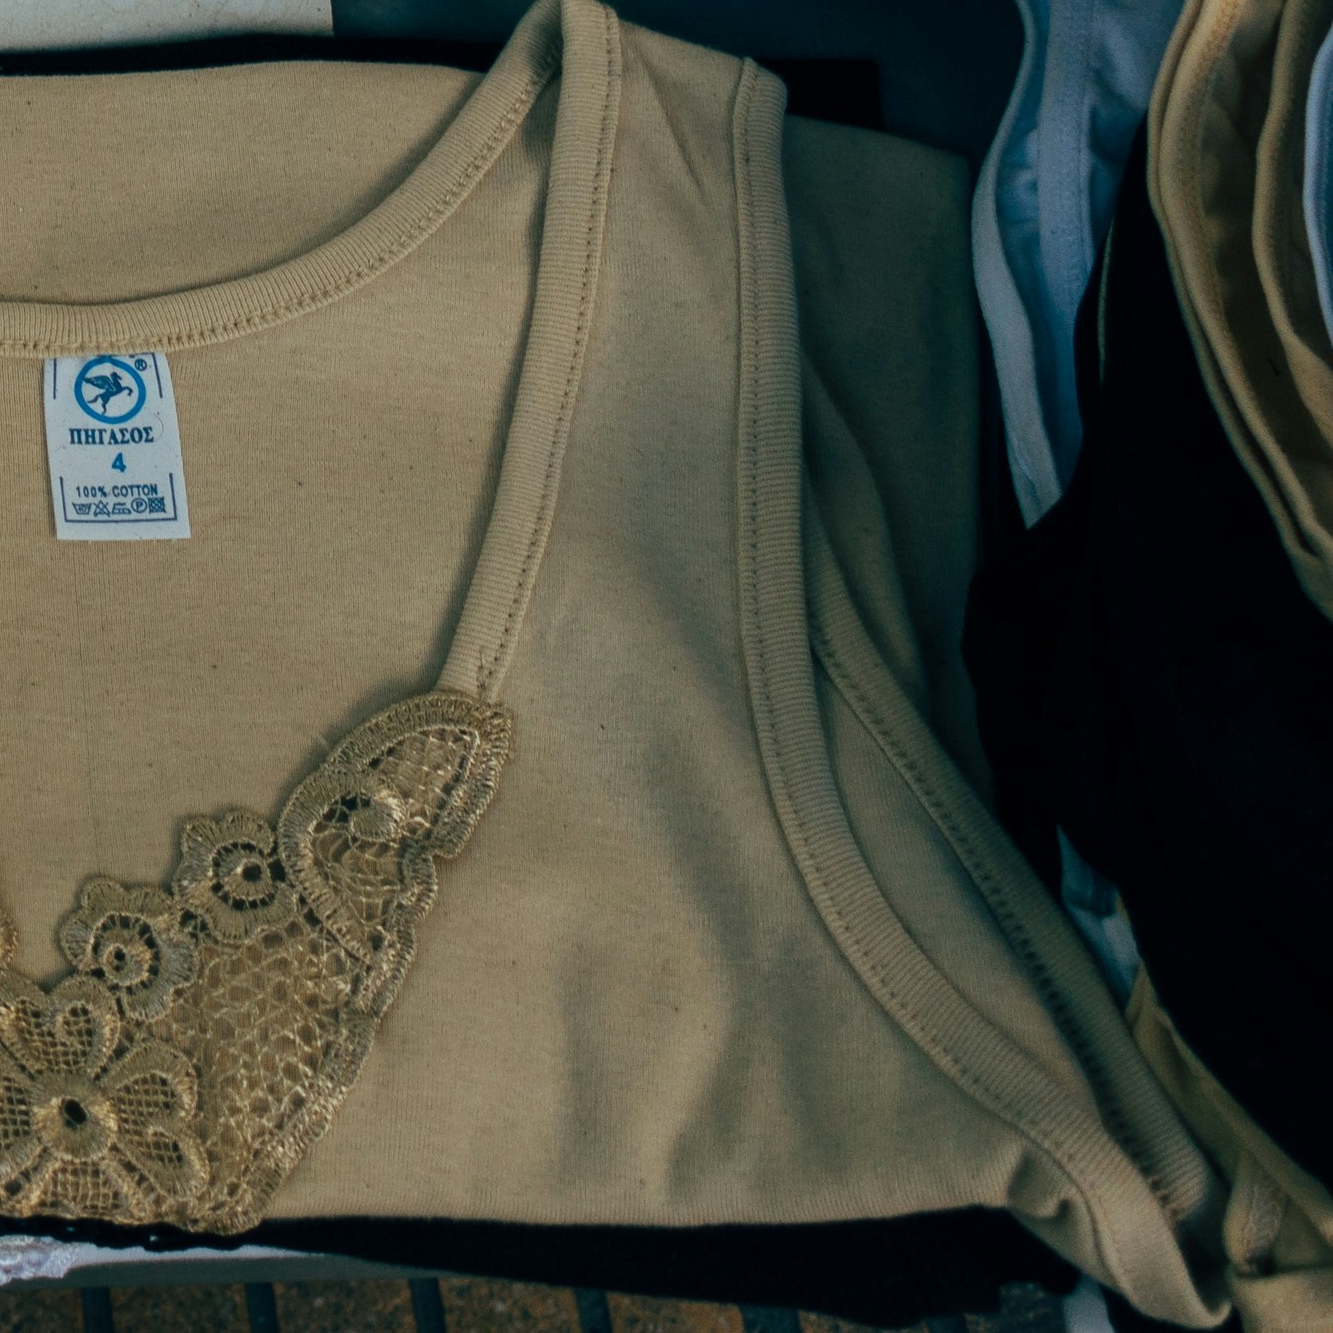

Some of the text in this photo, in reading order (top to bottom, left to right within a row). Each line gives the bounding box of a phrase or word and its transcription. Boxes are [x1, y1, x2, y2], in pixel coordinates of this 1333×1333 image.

[68, 426, 155, 446] ΠΗΓΑΣΟΣ
[111, 452, 127, 473] 4
[75, 483, 159, 499] 100% COTTON
